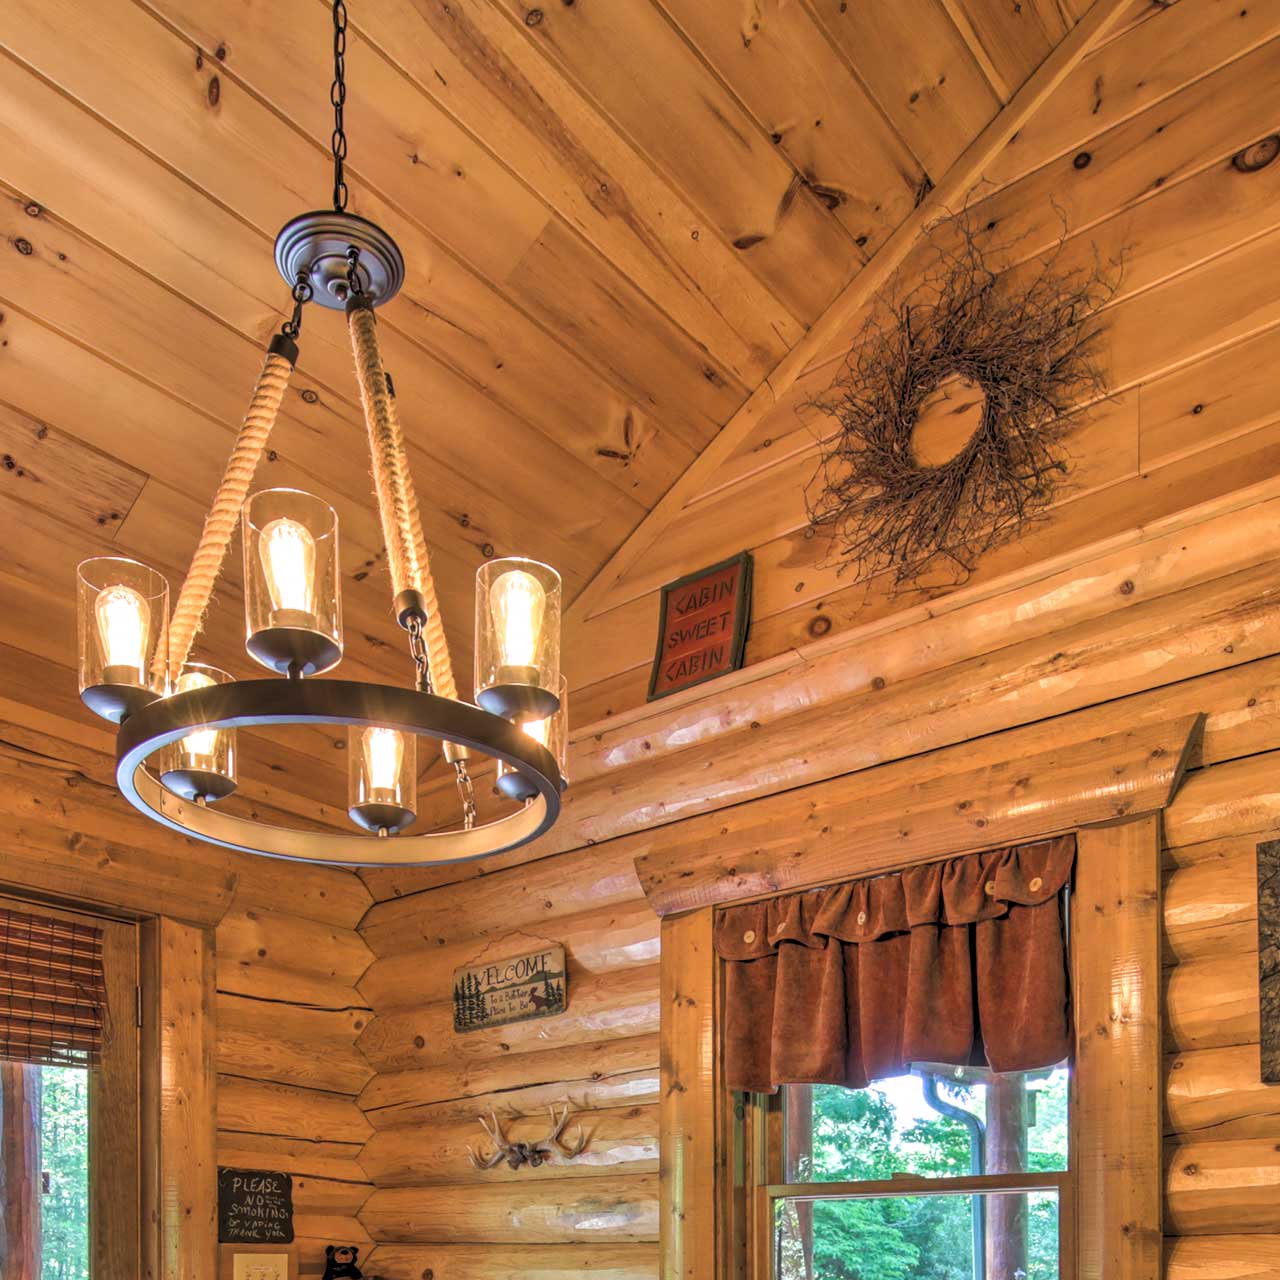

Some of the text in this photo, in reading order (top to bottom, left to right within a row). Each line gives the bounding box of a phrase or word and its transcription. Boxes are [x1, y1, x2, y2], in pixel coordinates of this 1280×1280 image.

[675, 576, 733, 614] CABIN
[668, 610, 731, 649] SWEET
[664, 646, 724, 682] CABIN
[472, 952, 552, 986] WELCOME
[233, 1178, 281, 1193] PLEASE
[244, 1194, 264, 1206] NO
